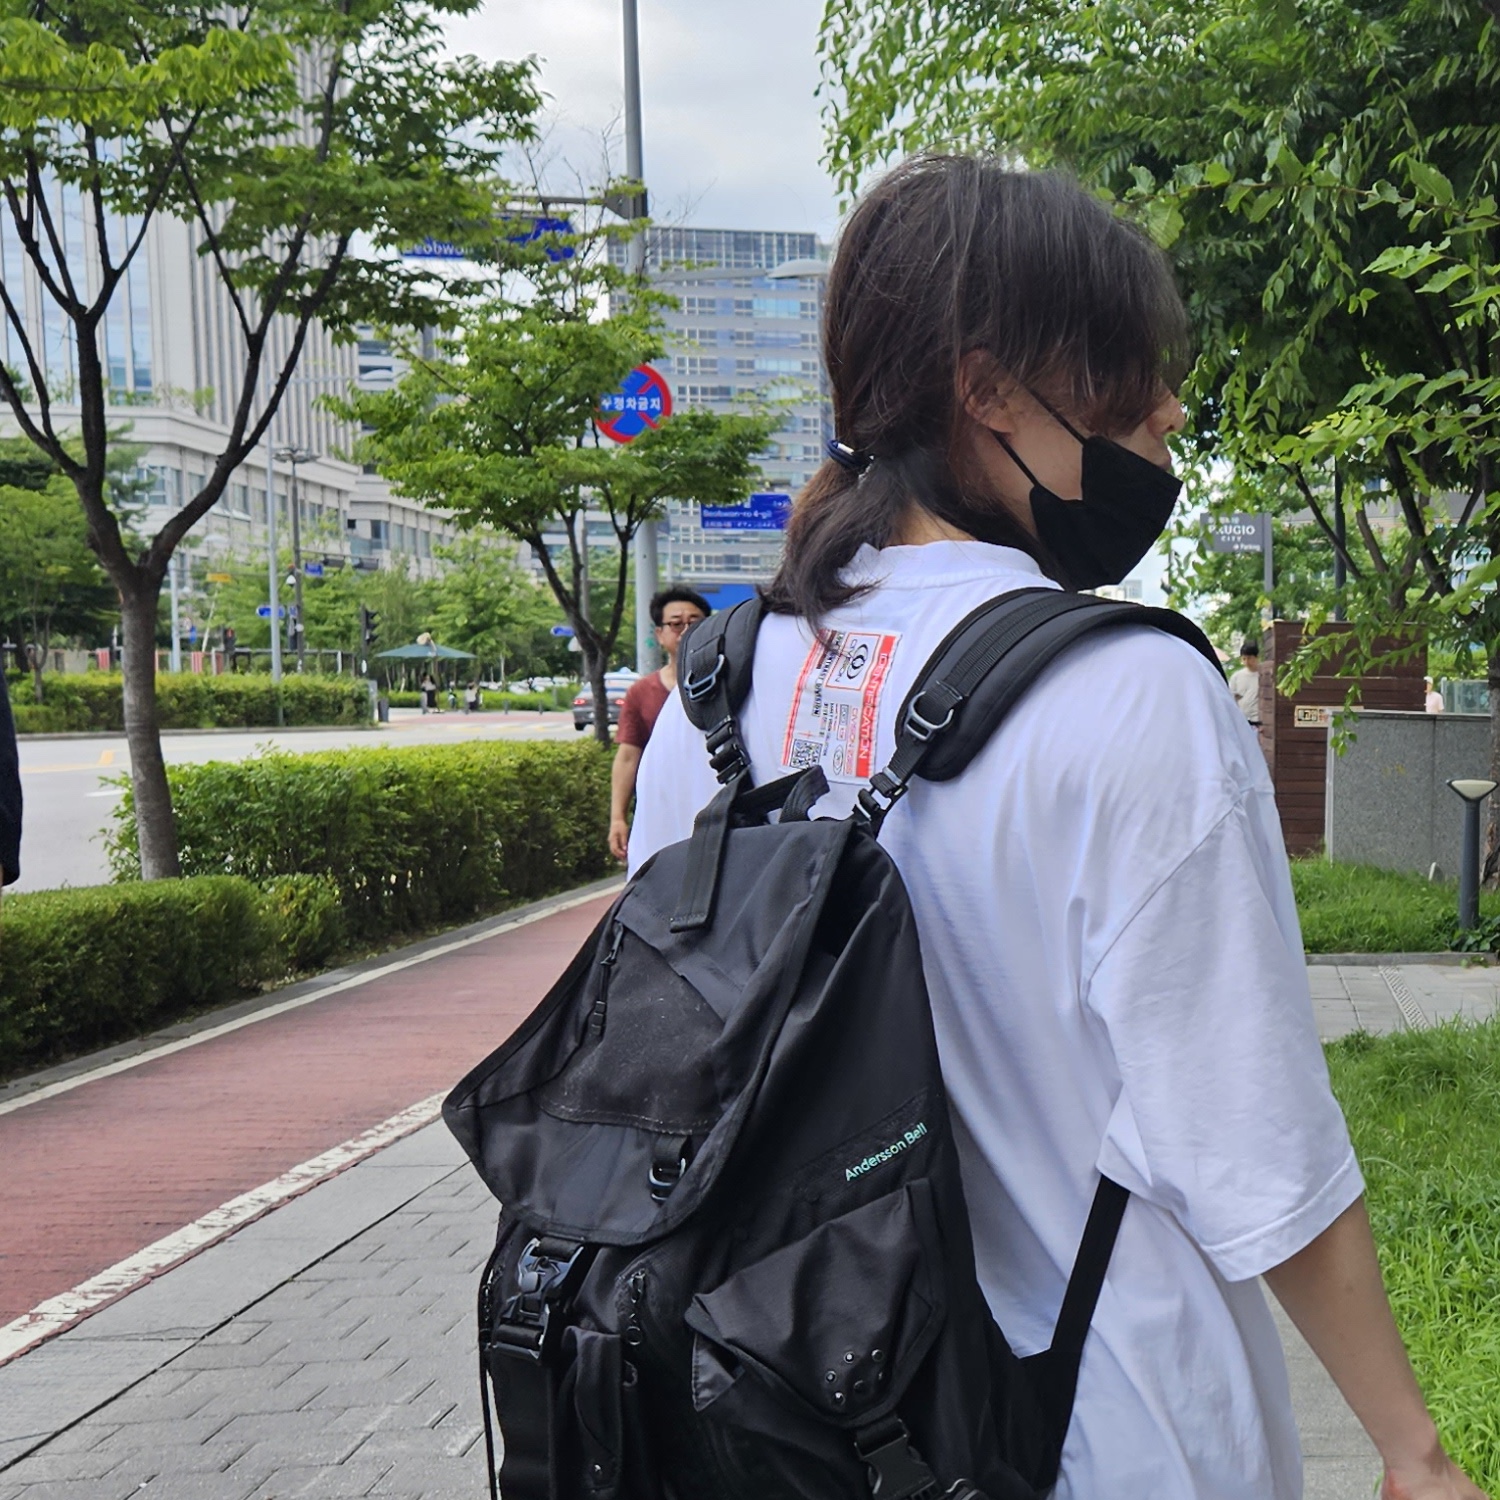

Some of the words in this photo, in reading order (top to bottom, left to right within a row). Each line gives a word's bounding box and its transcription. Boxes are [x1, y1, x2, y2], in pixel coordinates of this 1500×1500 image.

[858, 653, 888, 760] IDENTIFICATION
[845, 1140, 908, 1182] Andersson
[903, 1122, 928, 1145] Bell
